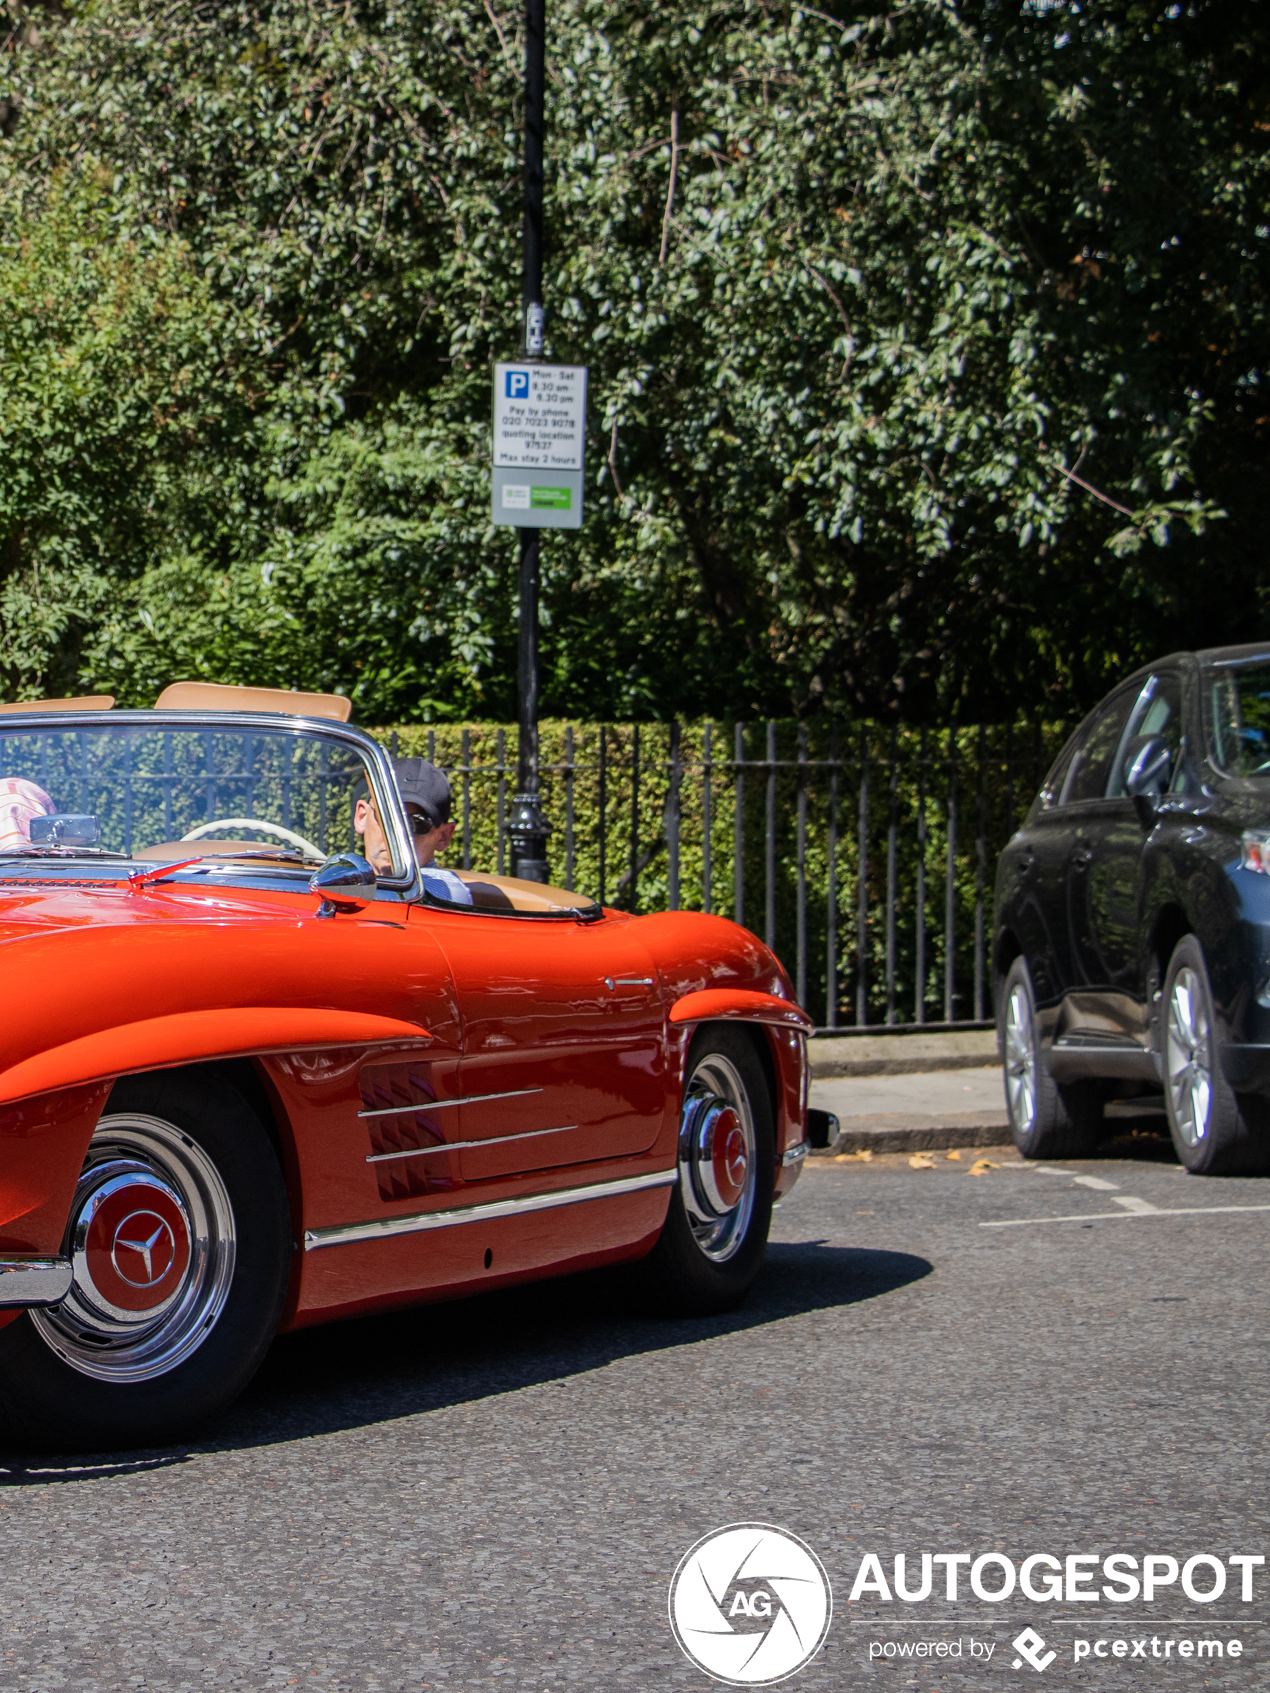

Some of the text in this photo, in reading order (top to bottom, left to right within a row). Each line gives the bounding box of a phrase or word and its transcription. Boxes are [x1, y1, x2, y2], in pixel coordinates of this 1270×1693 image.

[532, 370, 551, 378] Mon
[559, 370, 575, 380] Sat
[511, 373, 526, 397] P
[532, 382, 554, 391] 8.30
[536, 393, 574, 404] 6.30 pm
[509, 405, 569, 417] Pay by phone
[502, 416, 575, 428] 020 7023 9078
[502, 430, 575, 440] quoting location
[500, 452, 576, 464] Max stay 2 hours
